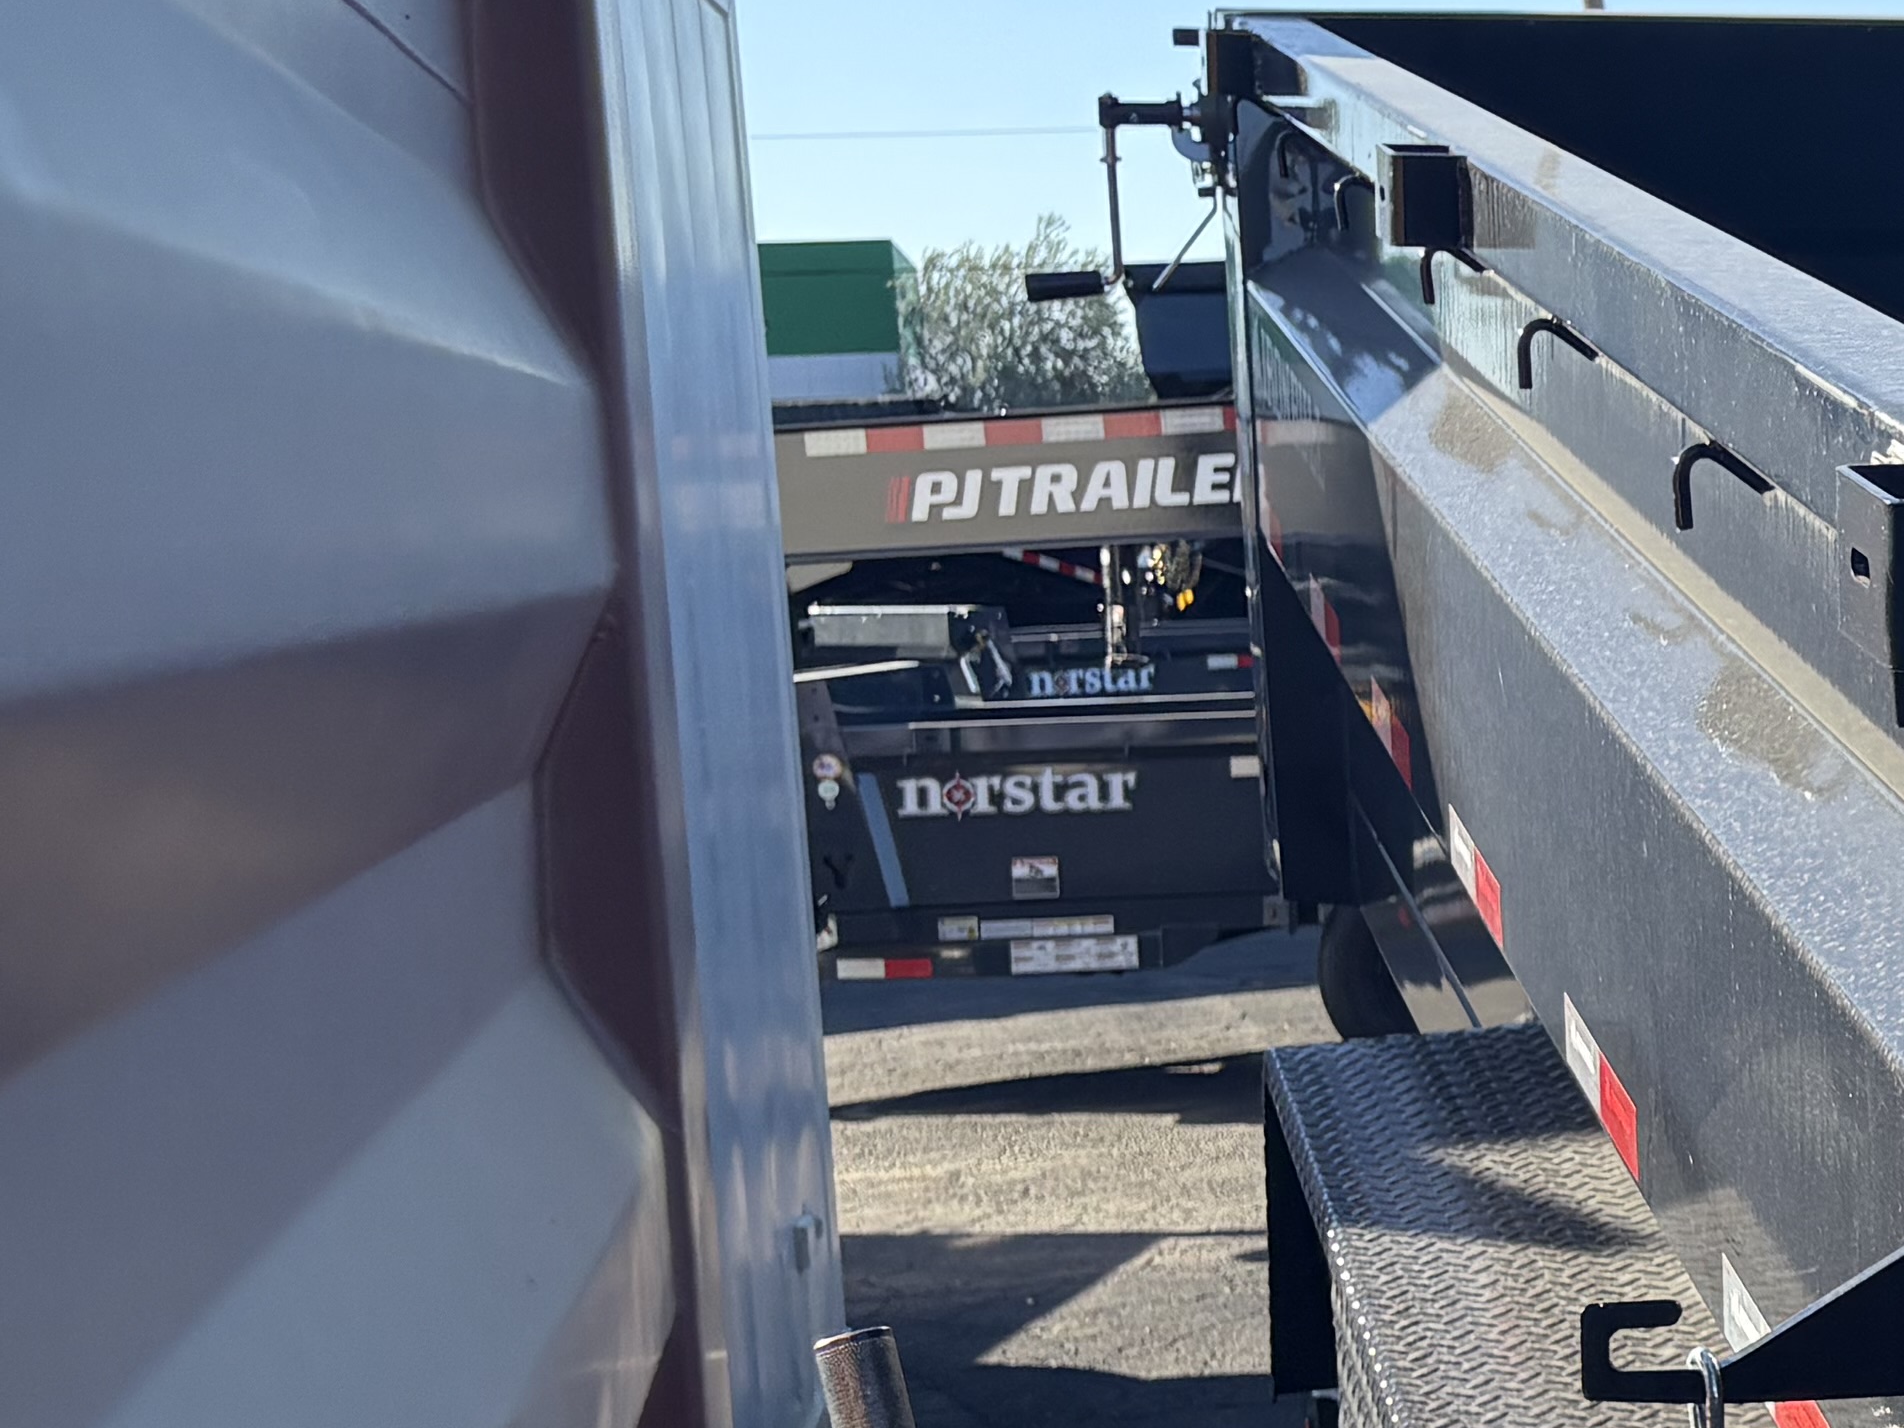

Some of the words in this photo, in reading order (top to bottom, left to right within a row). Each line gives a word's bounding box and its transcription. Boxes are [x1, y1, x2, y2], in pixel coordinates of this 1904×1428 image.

[911, 468, 983, 522] PJ
[990, 452, 1242, 517] TRAILE
[896, 765, 1138, 822] norstar
